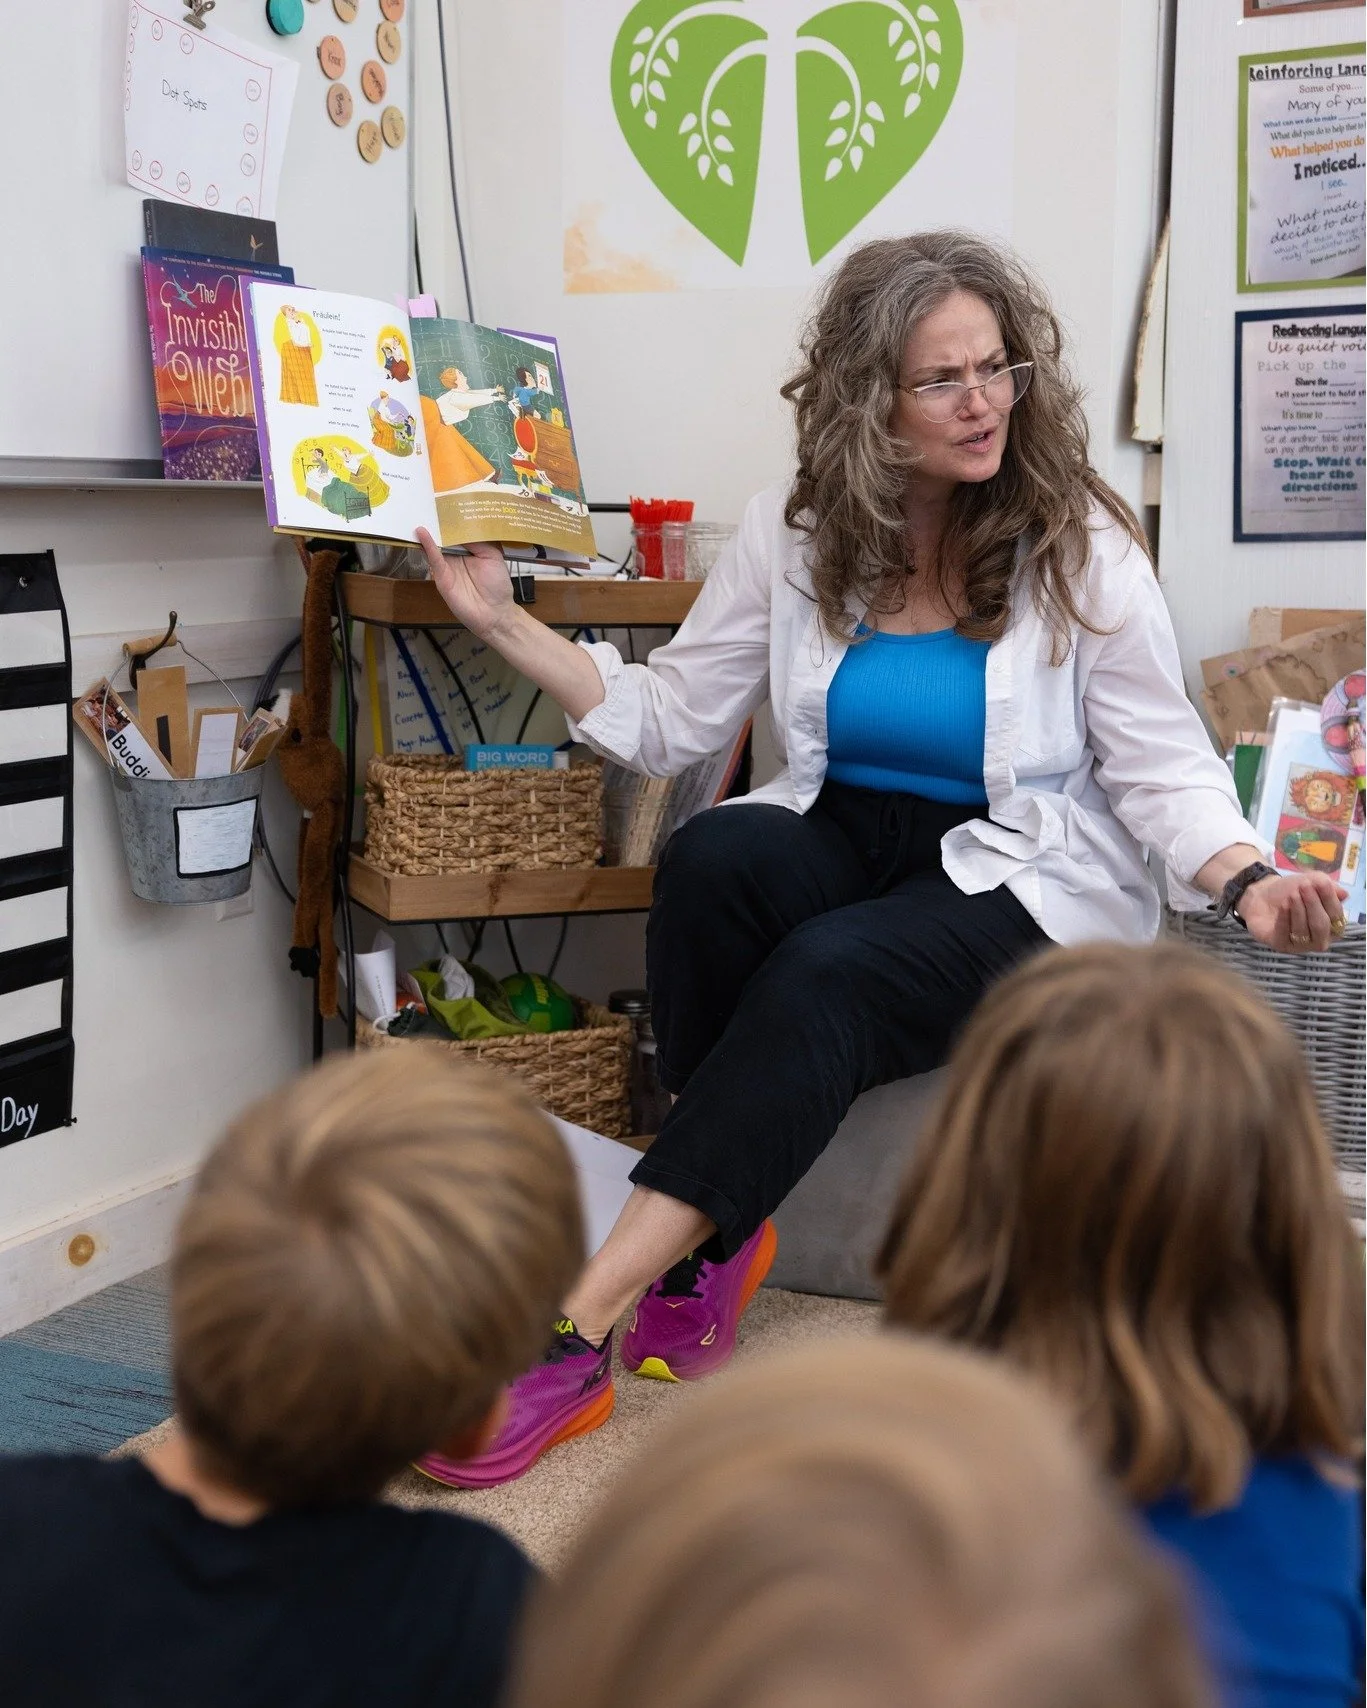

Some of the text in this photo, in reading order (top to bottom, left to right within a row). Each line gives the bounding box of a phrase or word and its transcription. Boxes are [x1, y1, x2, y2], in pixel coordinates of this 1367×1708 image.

[1338, 64, 1366, 77] Lang
[162, 79, 207, 111] Dot Spots
[1300, 83, 1324, 93] Some
[1327, 83, 1335, 92] of
[1288, 100, 1320, 114] Many
[1326, 95, 1341, 108] of
[1292, 130, 1302, 138] did
[1303, 130, 1315, 139] you
[1271, 135, 1364, 158] What helped you do
[1294, 163, 1301, 180] I
[1277, 200, 1360, 228] What made
[1270, 225, 1320, 244] decide
[1324, 219, 1338, 230] to
[1340, 213, 1358, 225] do
[198, 282, 216, 304] The
[312, 310, 340, 321] Fräulein!
[165, 303, 247, 351] Invisibl
[1272, 324, 1331, 338] Redirecting
[1268, 341, 1292, 354] Use
[1297, 340, 1339, 355] quiet
[1257, 360, 1346, 373] Pick up the
[171, 350, 246, 417] Web
[538, 374, 548, 388] 21
[1282, 410, 1294, 419] It's
[1296, 411, 1313, 419] time
[1273, 458, 1313, 469] Stop.
[1316, 456, 1351, 466] Wait
[1289, 469, 1354, 480] hear the
[1282, 483, 1358, 492] directions
[112, 734, 150, 778] Buddi
[476, 751, 549, 762] BIG WORD
[2, 1096, 39, 1138] Day
